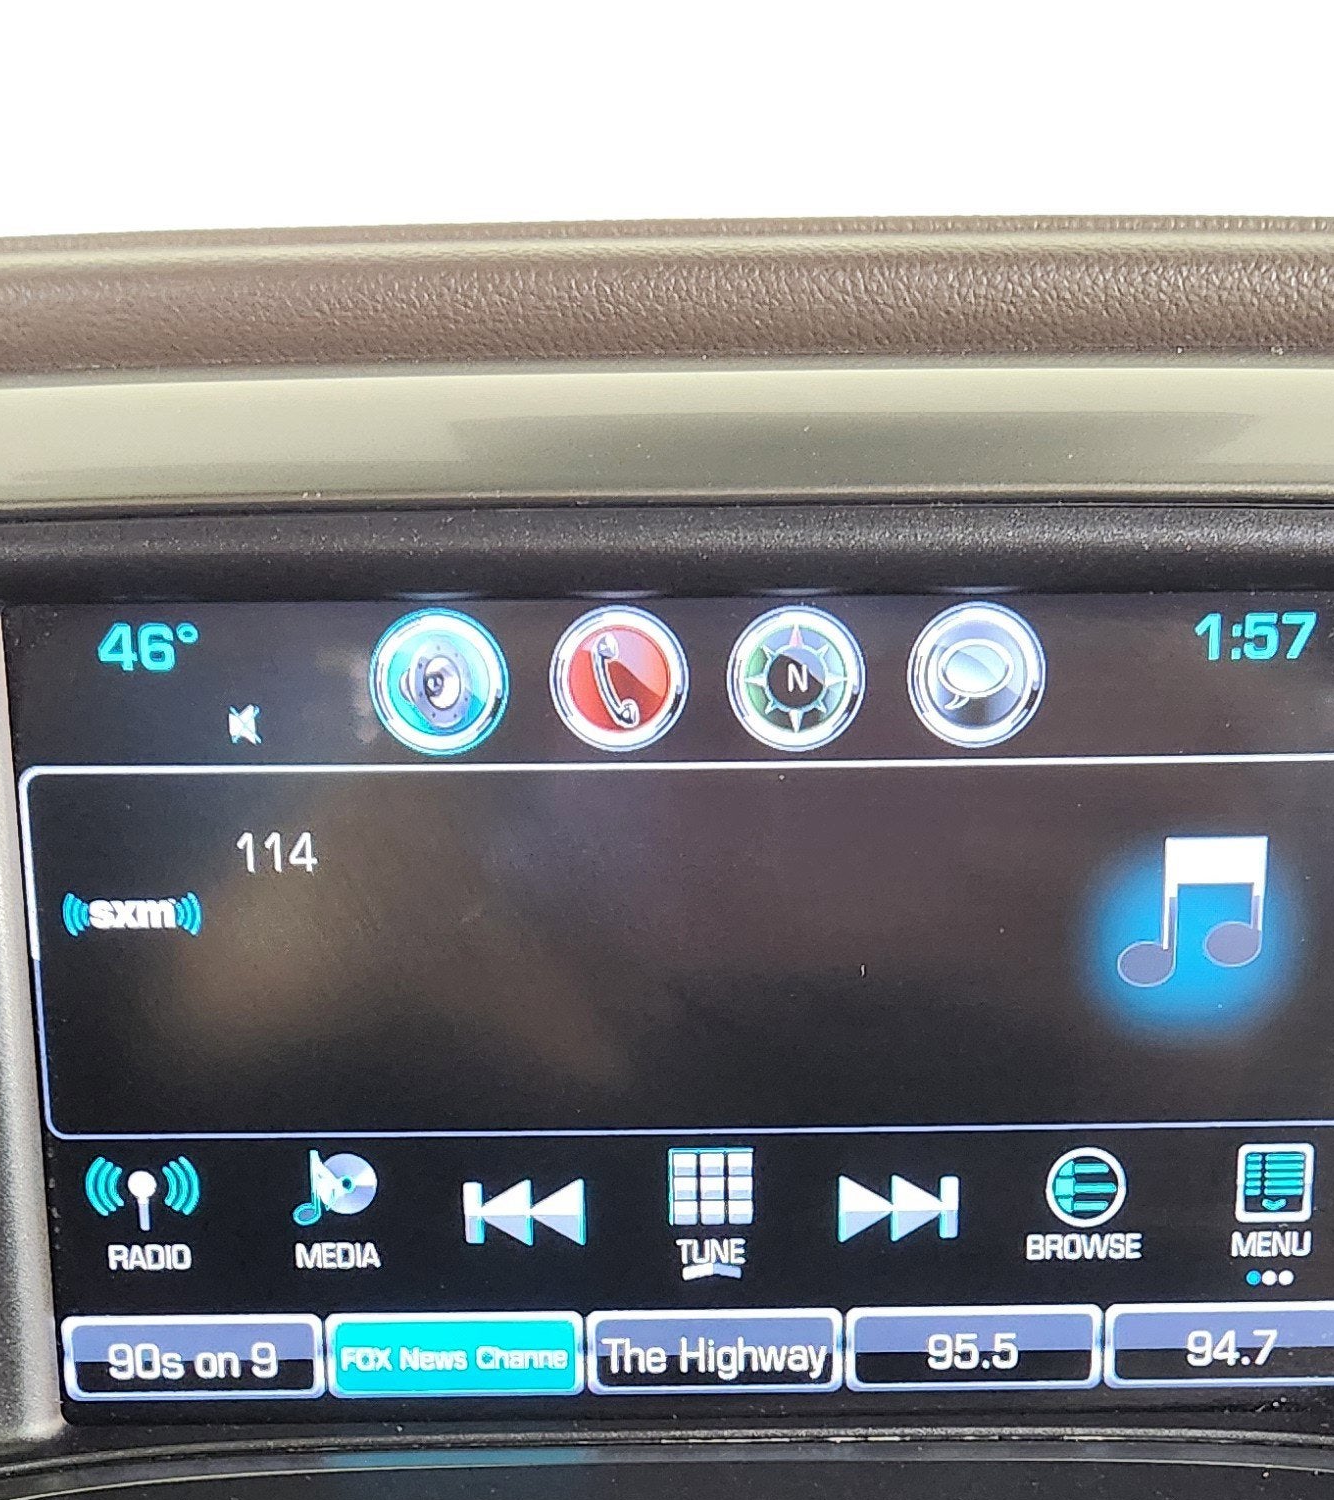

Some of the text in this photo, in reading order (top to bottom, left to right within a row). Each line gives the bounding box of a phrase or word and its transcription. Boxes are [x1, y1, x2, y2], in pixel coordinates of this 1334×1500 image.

[97, 622, 200, 672] 46°
[1194, 611, 1317, 661] 1:57
[787, 662, 809, 694] N
[236, 831, 318, 874] 114
[88, 898, 177, 929] sxm
[108, 1244, 192, 1271] RADIO
[295, 1242, 381, 1270] MEDIA
[675, 1237, 747, 1265] TUNE
[1026, 1233, 1142, 1261] BROWSE
[1231, 1231, 1312, 1258] MENU
[107, 1342, 278, 1381] 90s on 9
[340, 1346, 392, 1372] FOX
[400, 1346, 467, 1372] News
[602, 1336, 828, 1381] The Highway
[926, 1333, 1019, 1371] 95.5
[1185, 1329, 1279, 1368] 94.7
